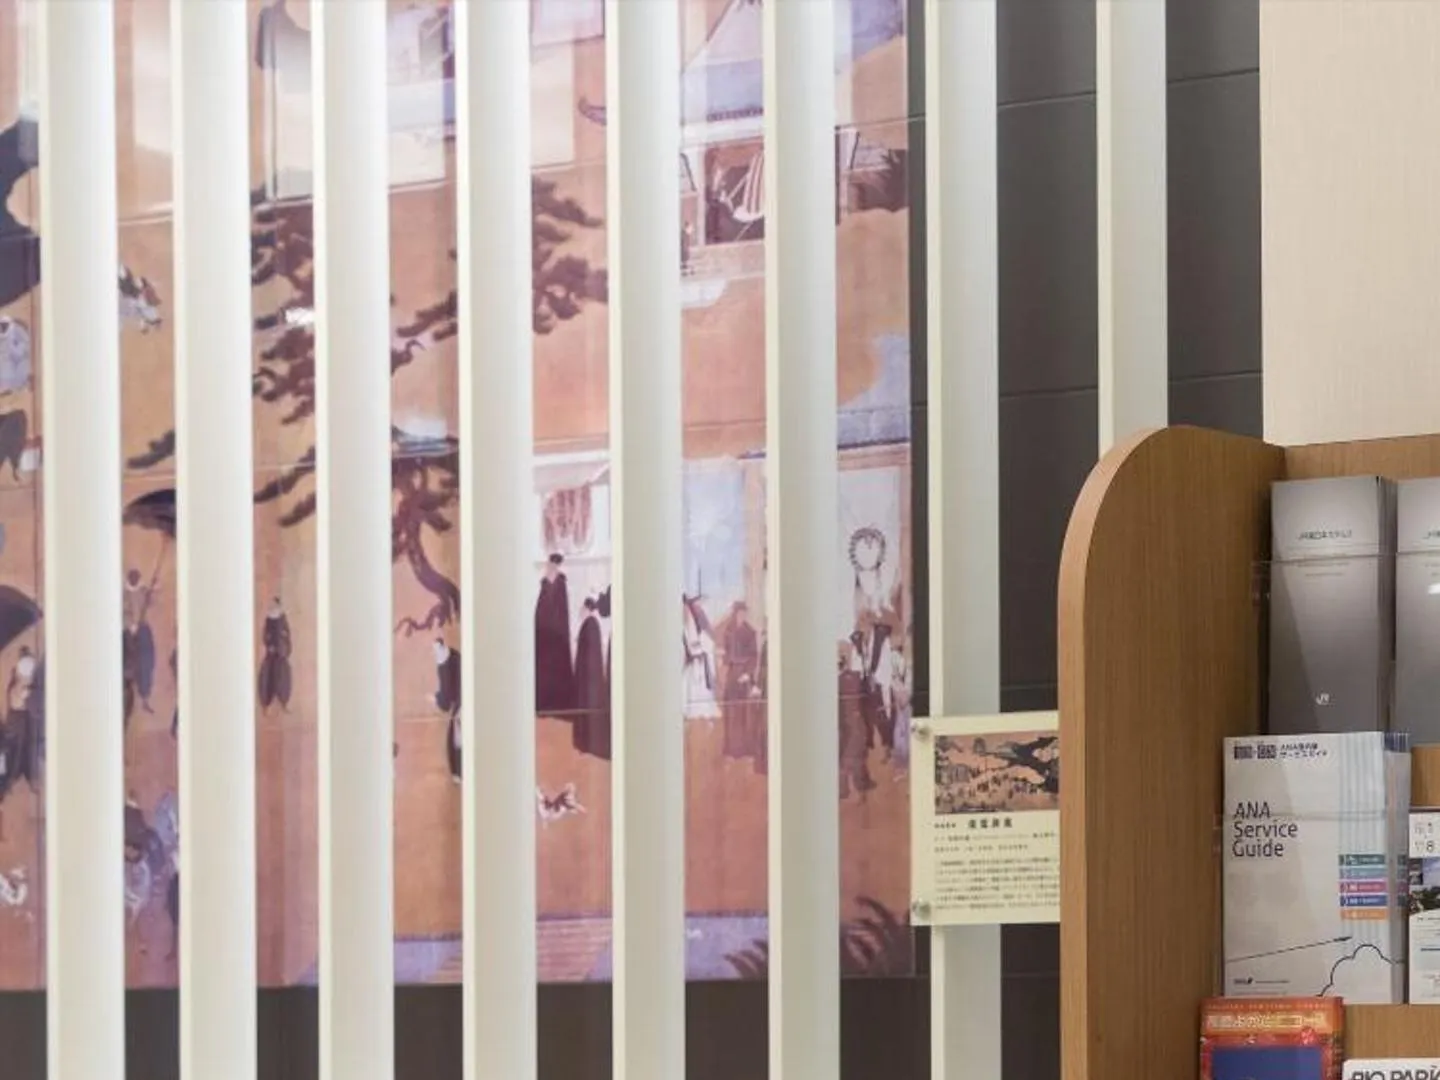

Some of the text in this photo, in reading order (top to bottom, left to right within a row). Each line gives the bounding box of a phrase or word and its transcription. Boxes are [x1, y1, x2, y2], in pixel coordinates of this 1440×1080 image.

[1233, 801, 1270, 819] ANA
[1233, 820, 1298, 838] Service
[1232, 839, 1284, 858] Guide
